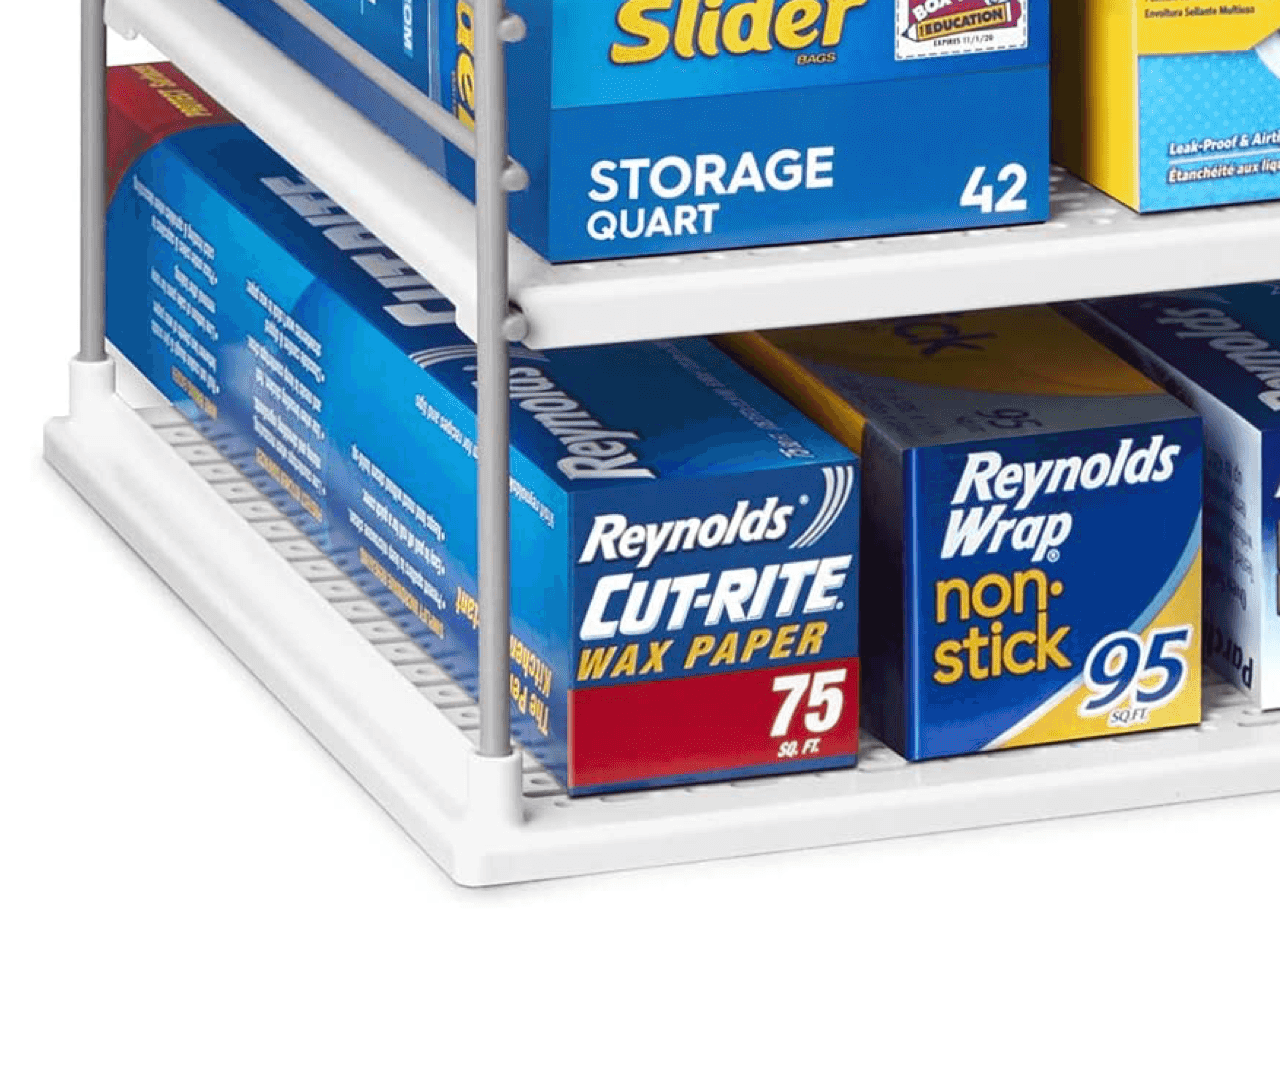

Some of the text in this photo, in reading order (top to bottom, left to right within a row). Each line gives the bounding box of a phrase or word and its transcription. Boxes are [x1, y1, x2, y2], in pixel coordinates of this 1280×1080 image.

[925, 7, 1004, 35] EDUCATION
[796, 51, 836, 66] BAGS
[589, 146, 835, 202] STORAGE
[1169, 135, 1238, 156] Leak-Proof
[1239, 134, 1250, 147] &
[1237, 162, 1259, 175] aux
[586, 162, 1028, 242] QUART 42
[952, 435, 1181, 511] Reynolds
[578, 496, 794, 569] Reynolds
[941, 506, 1072, 562] Wrap
[579, 554, 852, 641] CUT-RITE
[576, 621, 829, 682] WAX PAPER
[932, 624, 1073, 686] stick
[1082, 625, 1192, 713] 95
[769, 668, 847, 738] 75
[777, 738, 821, 758] SQ. FT.
